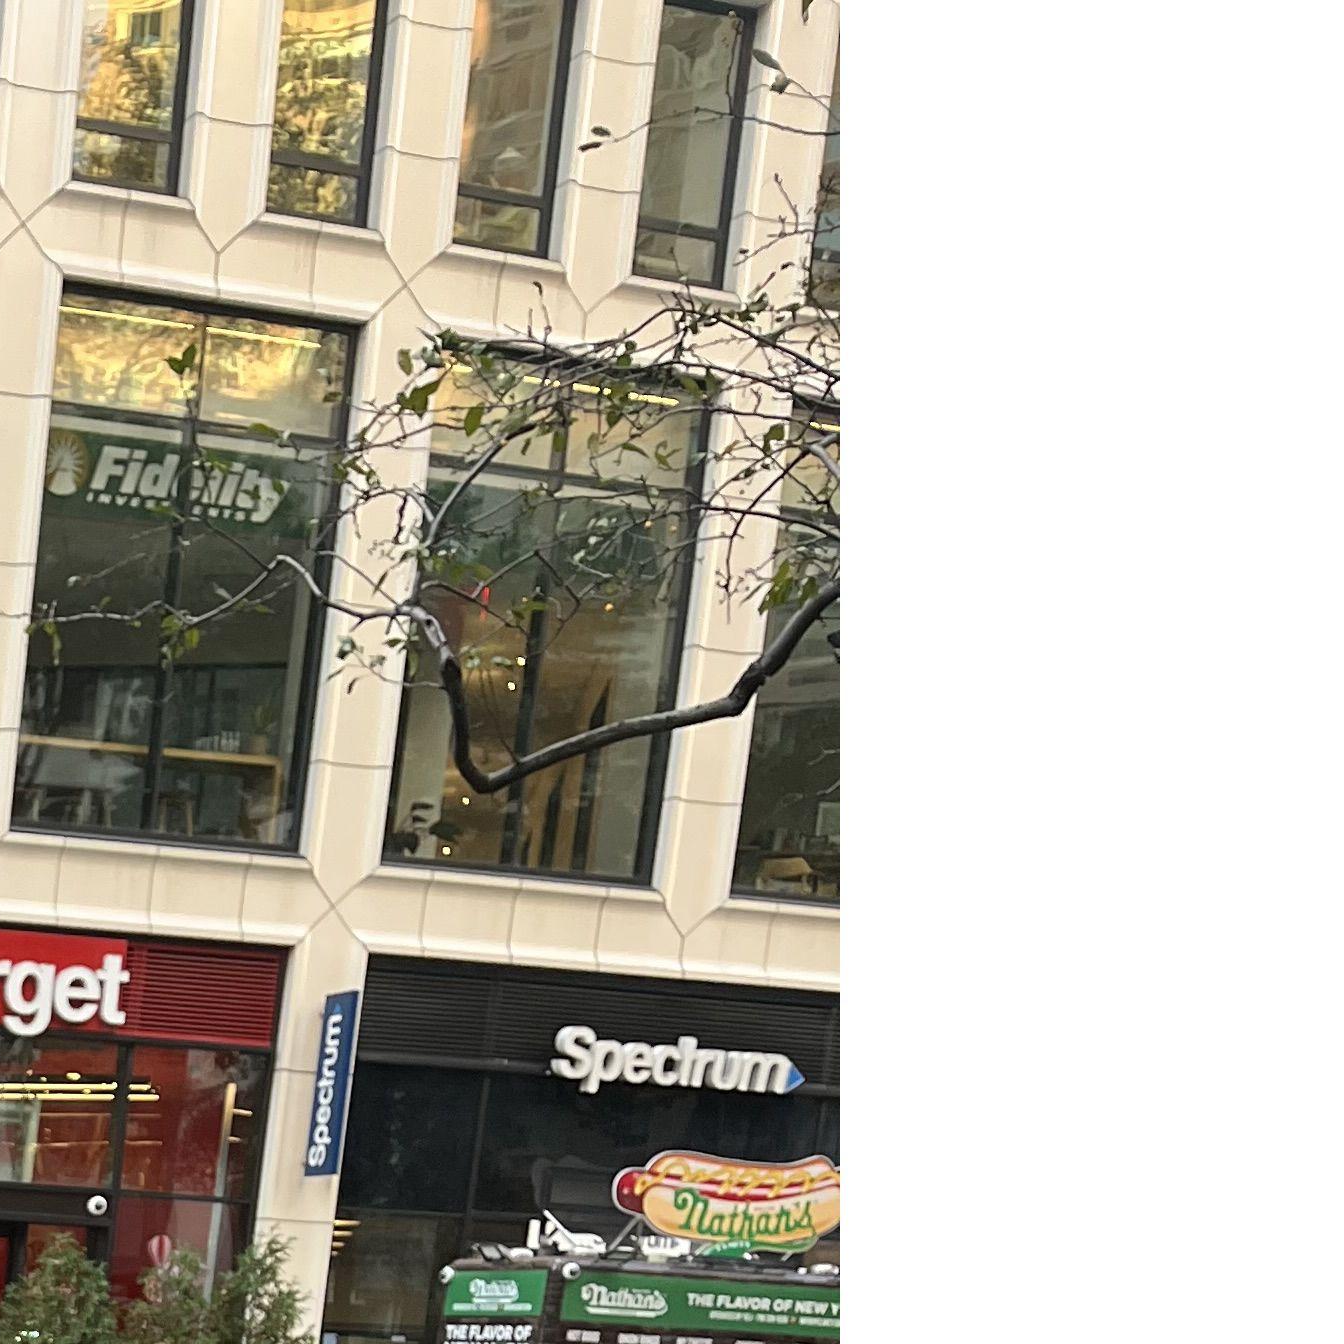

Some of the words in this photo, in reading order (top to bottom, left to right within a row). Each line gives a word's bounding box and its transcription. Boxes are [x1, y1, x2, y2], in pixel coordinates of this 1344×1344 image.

[550, 1024, 793, 1094] Spectrum
[308, 1014, 343, 1167] Spectrum
[673, 1187, 817, 1241] Nathan's
[687, 1292, 715, 1308] THE
[716, 1294, 772, 1312] FLAVOR
[773, 1297, 794, 1313] OF
[794, 1299, 827, 1316] NEW
[445, 1324, 468, 1340] THE
[469, 1324, 513, 1342] FLAVOR
[514, 1324, 533, 1342] OF
